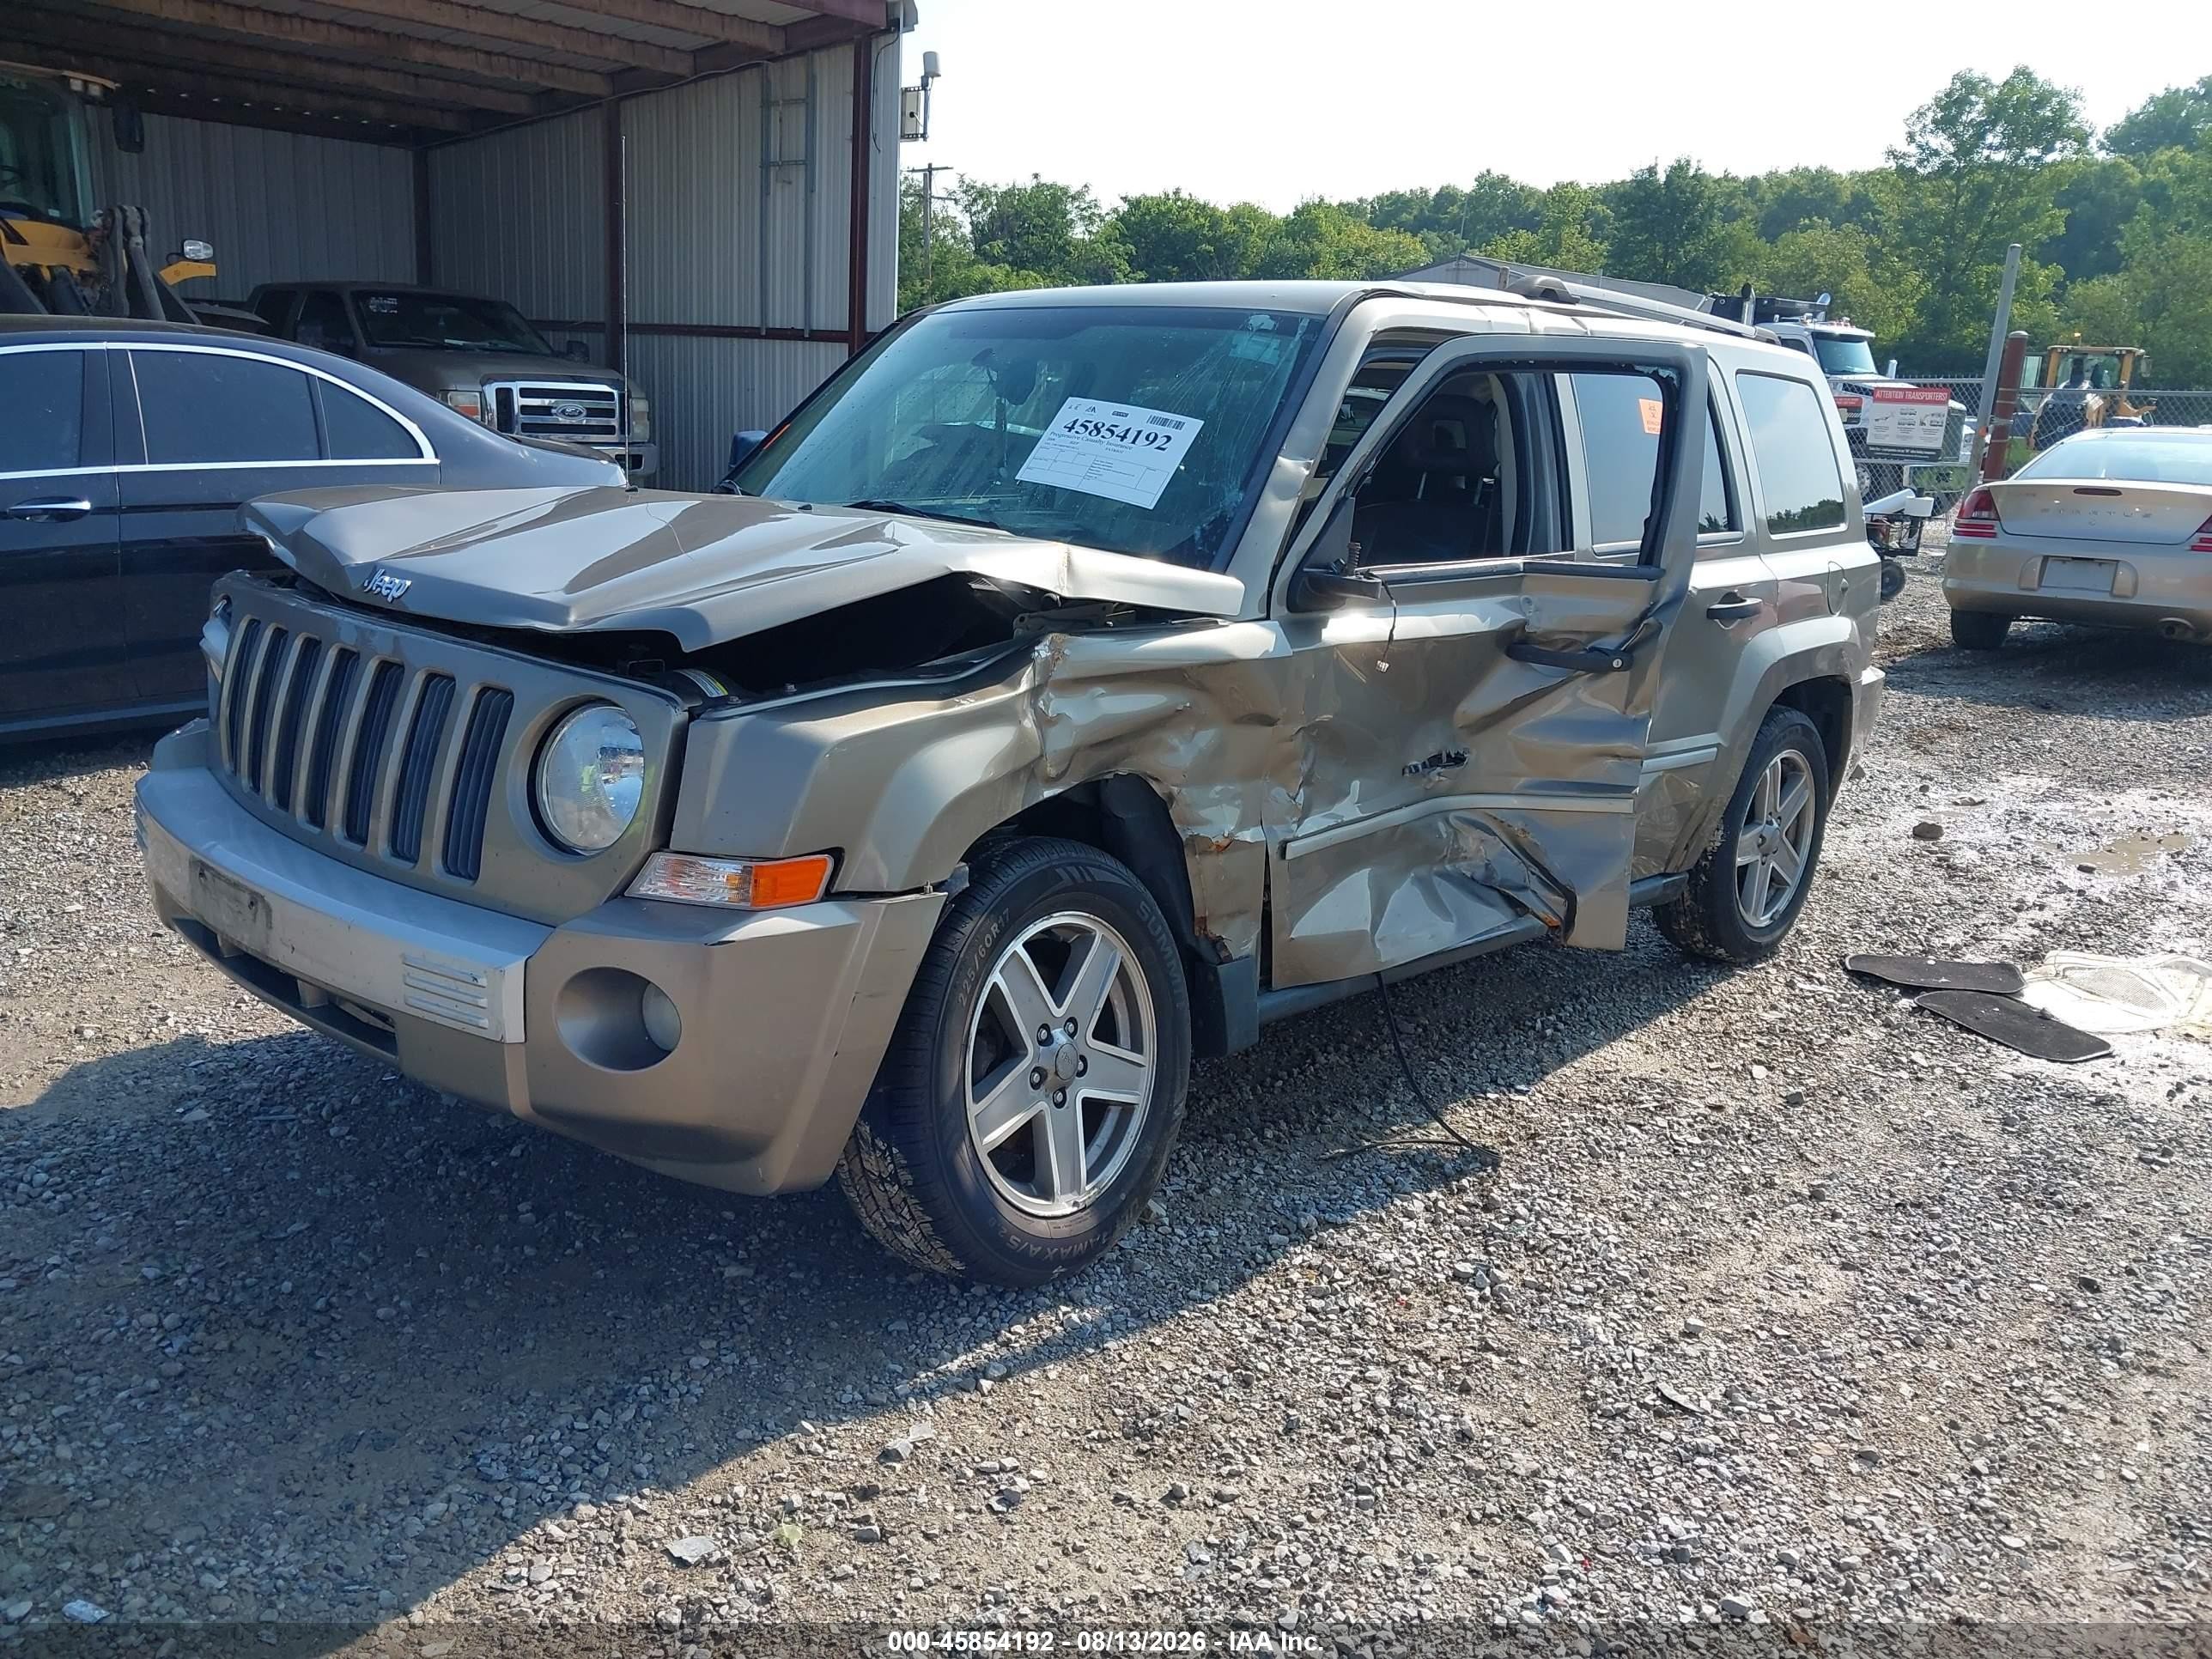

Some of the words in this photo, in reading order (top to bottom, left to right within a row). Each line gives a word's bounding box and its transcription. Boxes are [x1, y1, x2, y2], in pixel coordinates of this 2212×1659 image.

[1875, 390, 1905, 399] ATTENTION
[1905, 391, 1948, 401] TRANSPORTERS!
[1049, 431, 1081, 441] Progressive
[1081, 434, 1106, 446] Casualty
[1105, 440, 1134, 451] Insurance
[1063, 417, 1173, 452] 45854192
[363, 568, 412, 604] Jeep
[957, 907, 1012, 1008] 225/60R17
